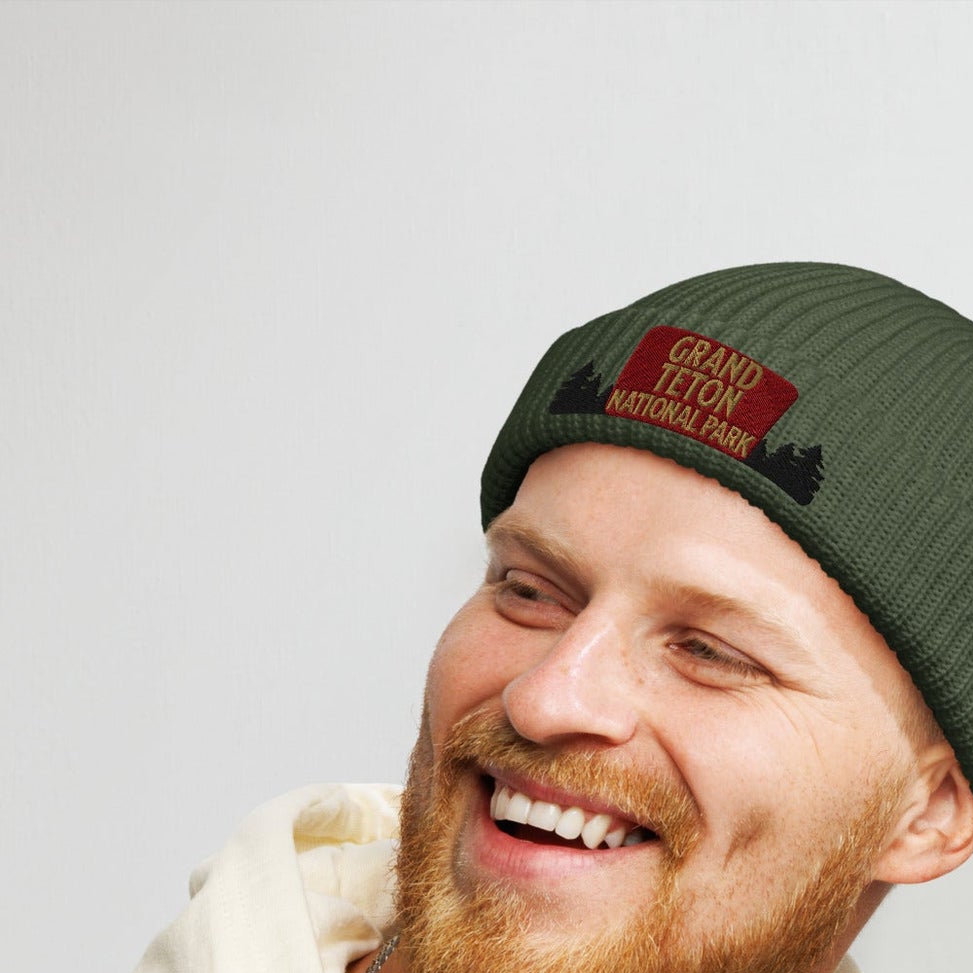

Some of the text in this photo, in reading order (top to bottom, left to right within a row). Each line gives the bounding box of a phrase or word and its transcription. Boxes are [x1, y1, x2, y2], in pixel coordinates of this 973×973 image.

[653, 362, 744, 418] TETON
[669, 336, 764, 390] GRAND
[605, 388, 757, 458] NATIONAL PARK
